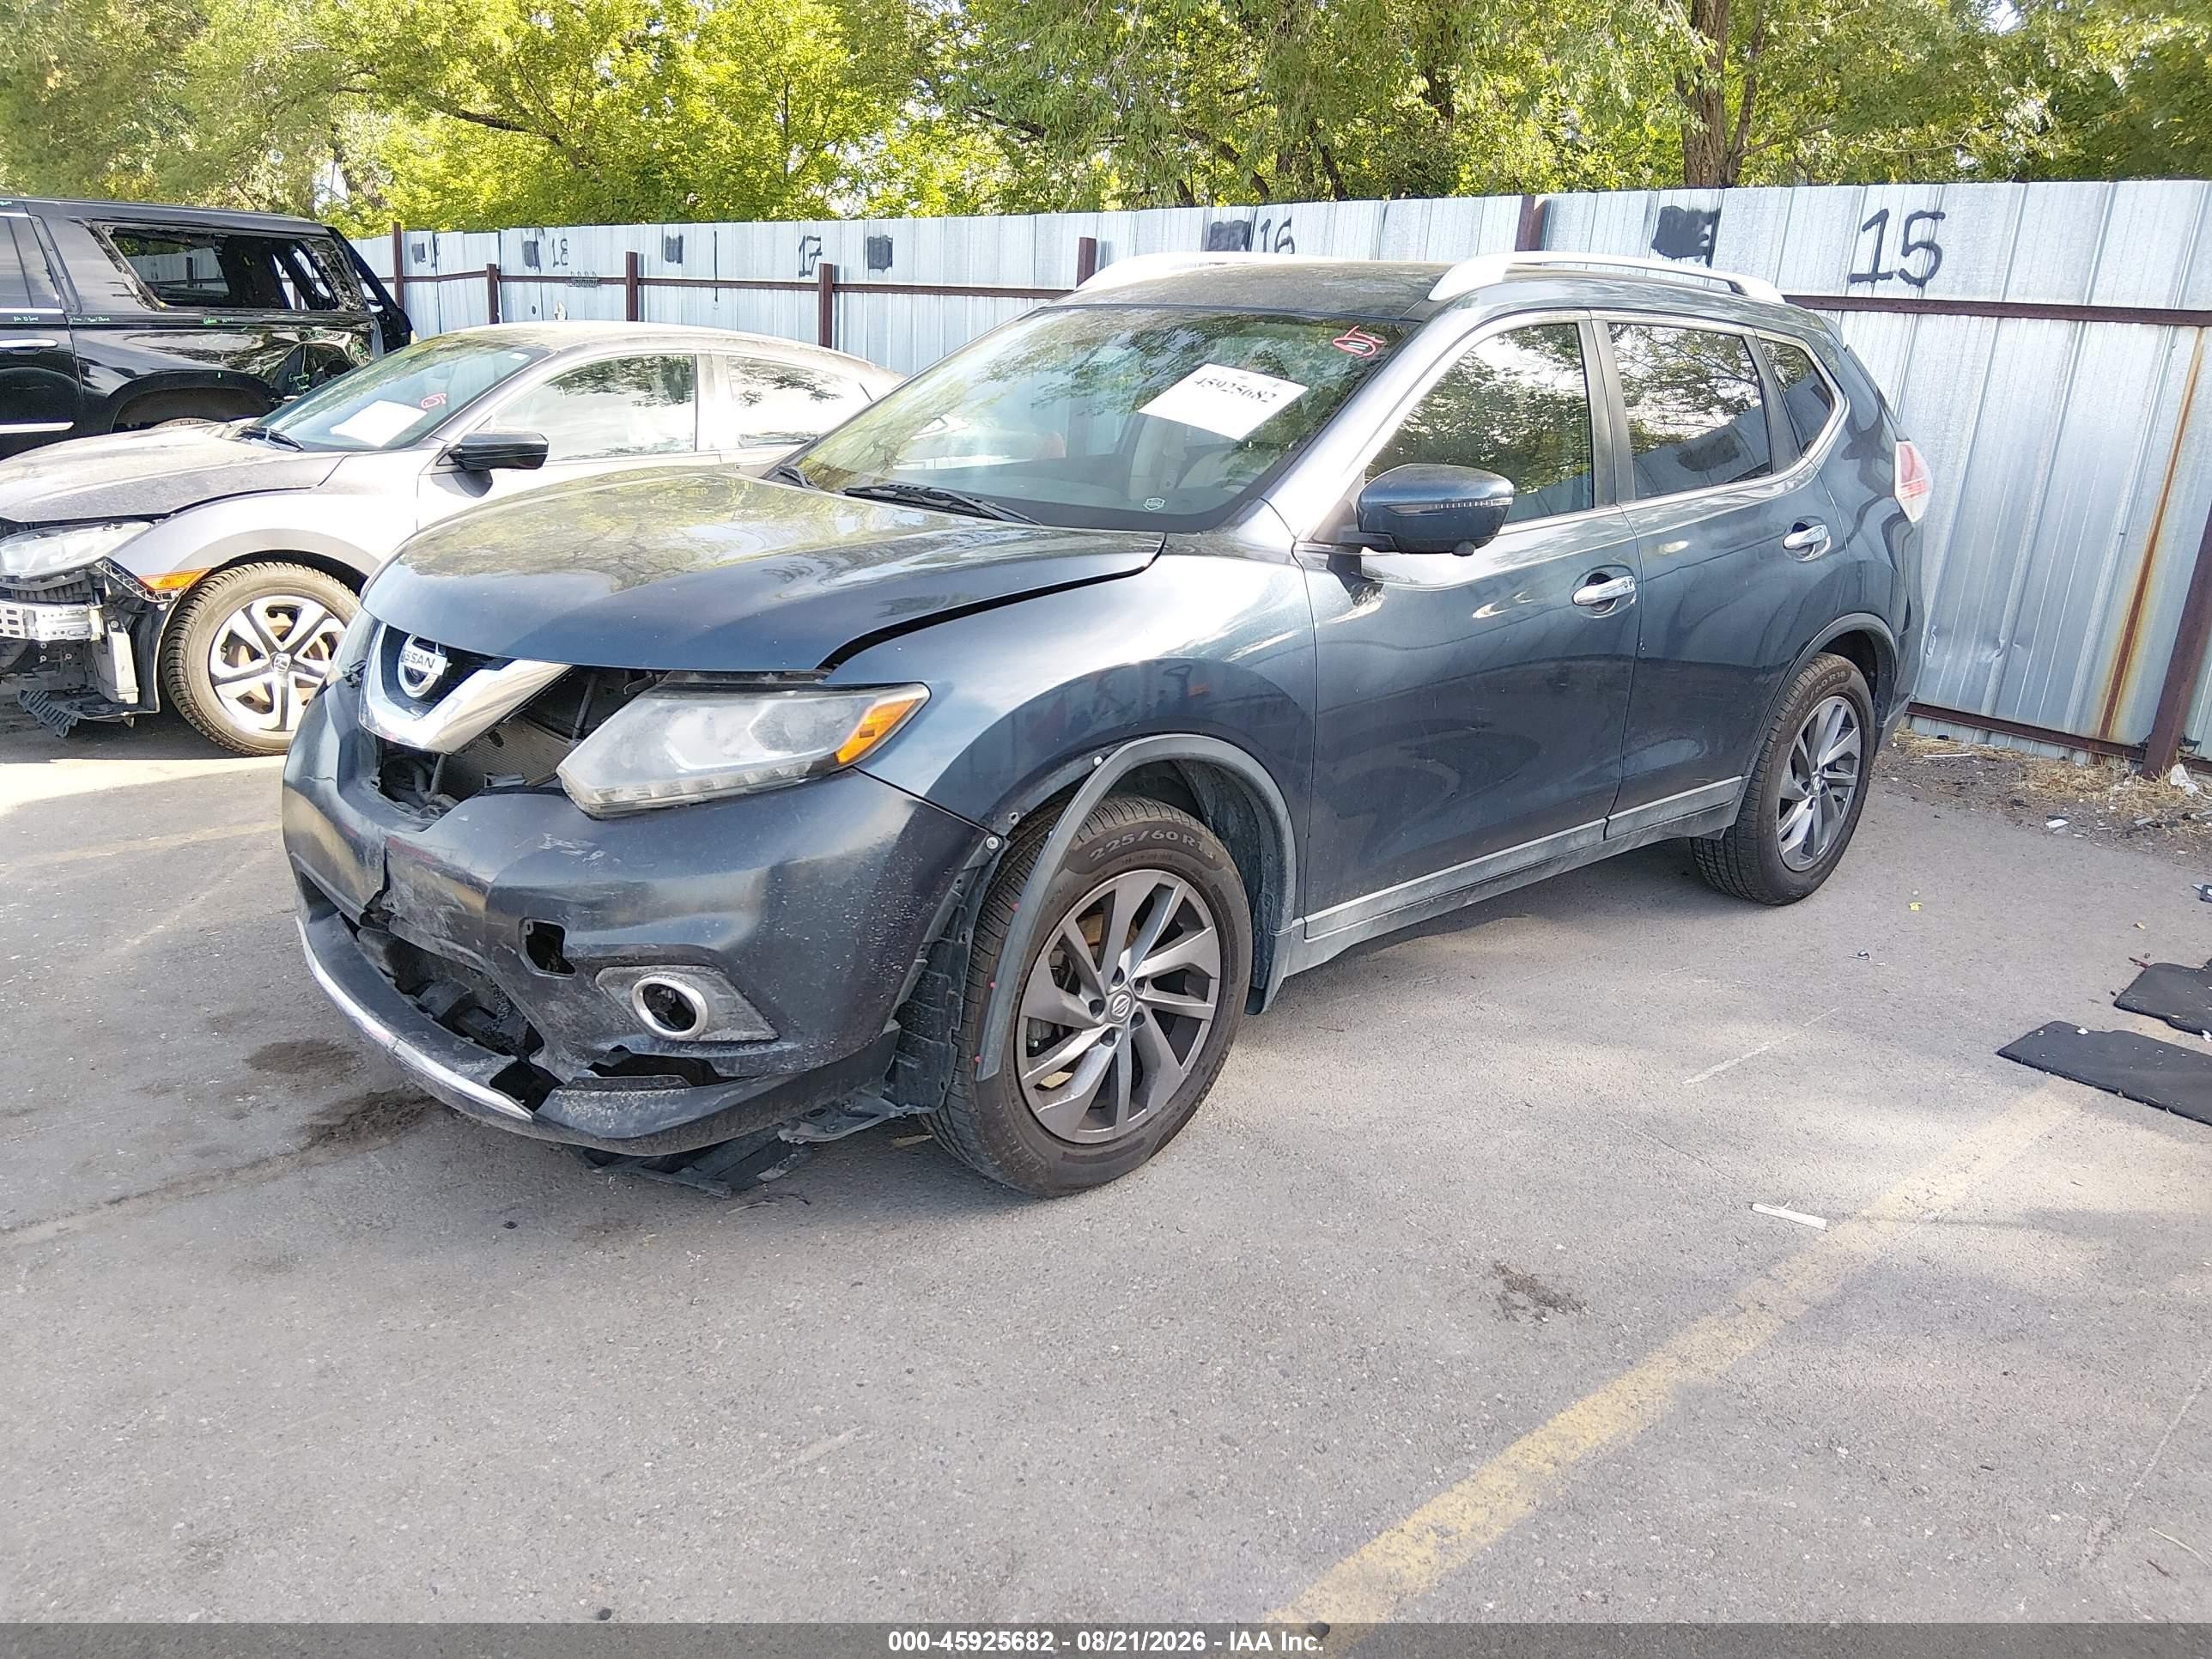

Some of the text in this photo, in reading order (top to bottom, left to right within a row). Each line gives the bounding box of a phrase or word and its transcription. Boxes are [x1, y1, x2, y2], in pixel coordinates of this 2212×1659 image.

[550, 237, 569, 269] 18
[1259, 216, 1296, 255] 16
[1848, 208, 1947, 288] 15
[1088, 830, 1180, 862] 225/60
